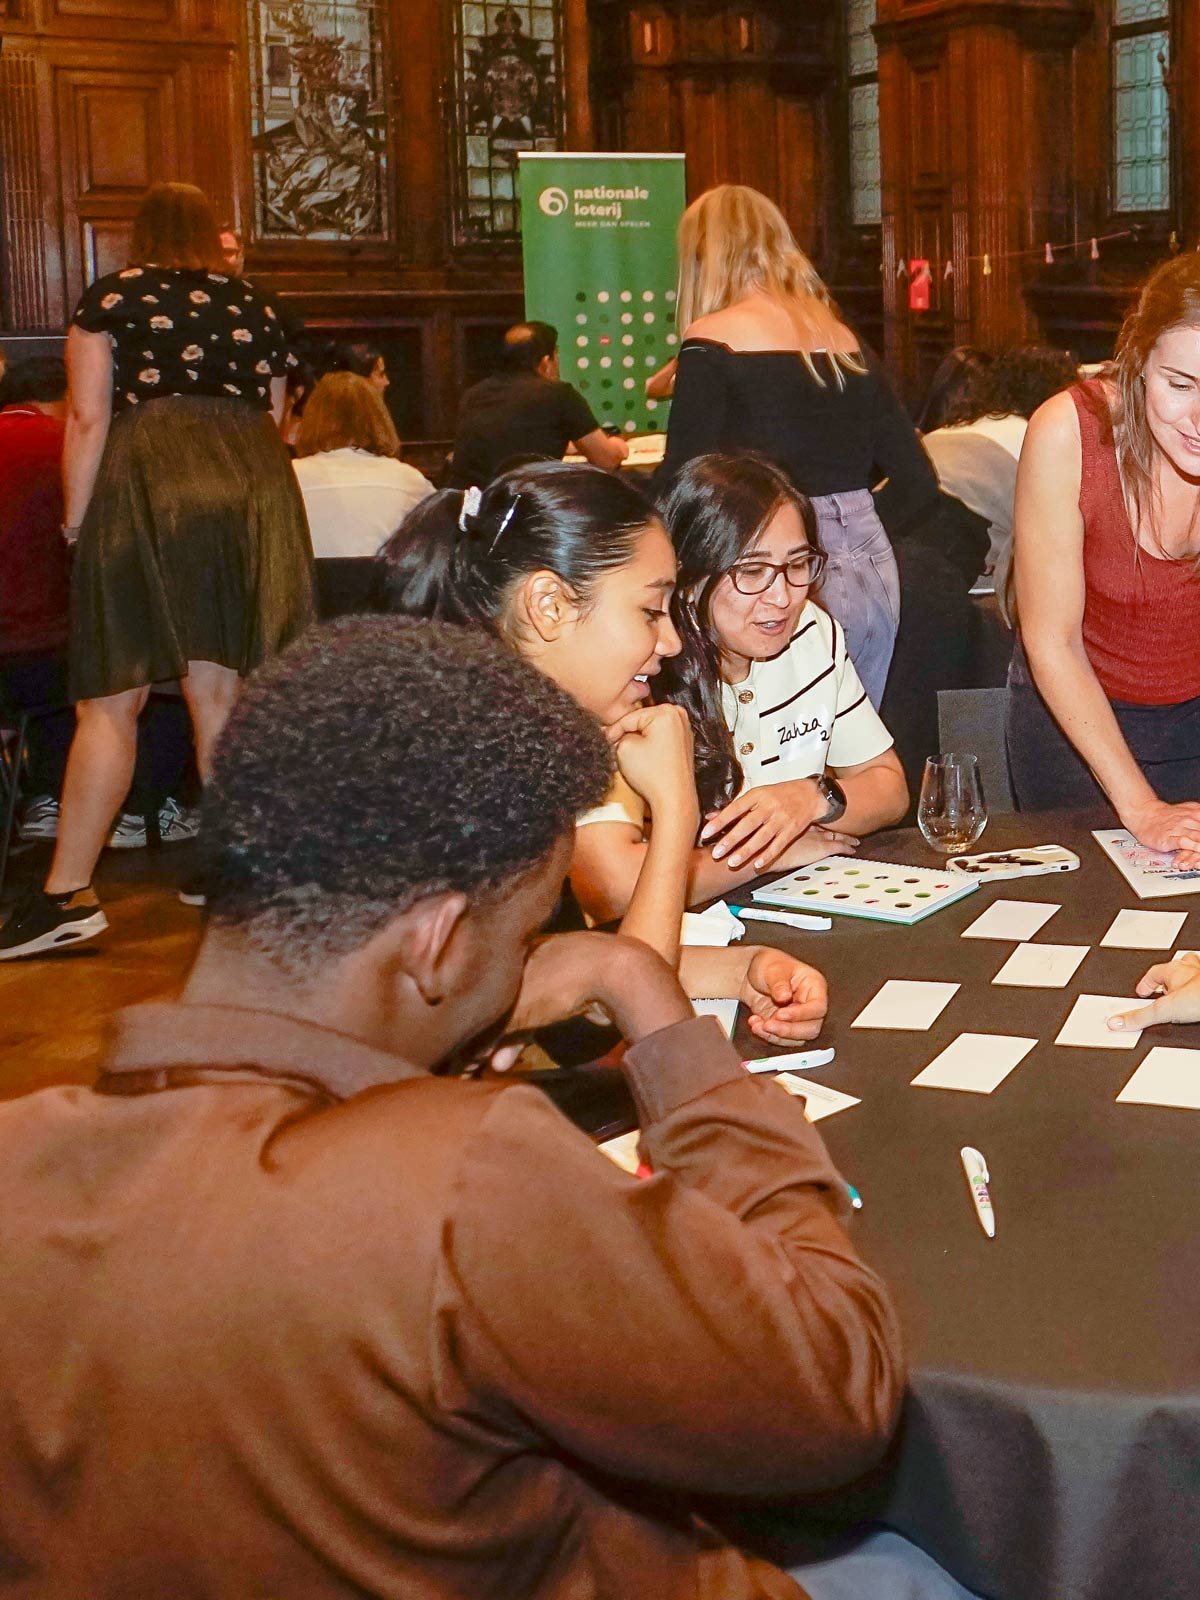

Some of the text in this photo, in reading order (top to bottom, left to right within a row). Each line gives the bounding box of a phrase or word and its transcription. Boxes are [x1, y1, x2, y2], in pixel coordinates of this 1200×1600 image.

[574, 186, 649, 199] nationale
[574, 202, 622, 220] loterij
[777, 717, 822, 745] Zahra
[820, 729, 830, 742] 2
